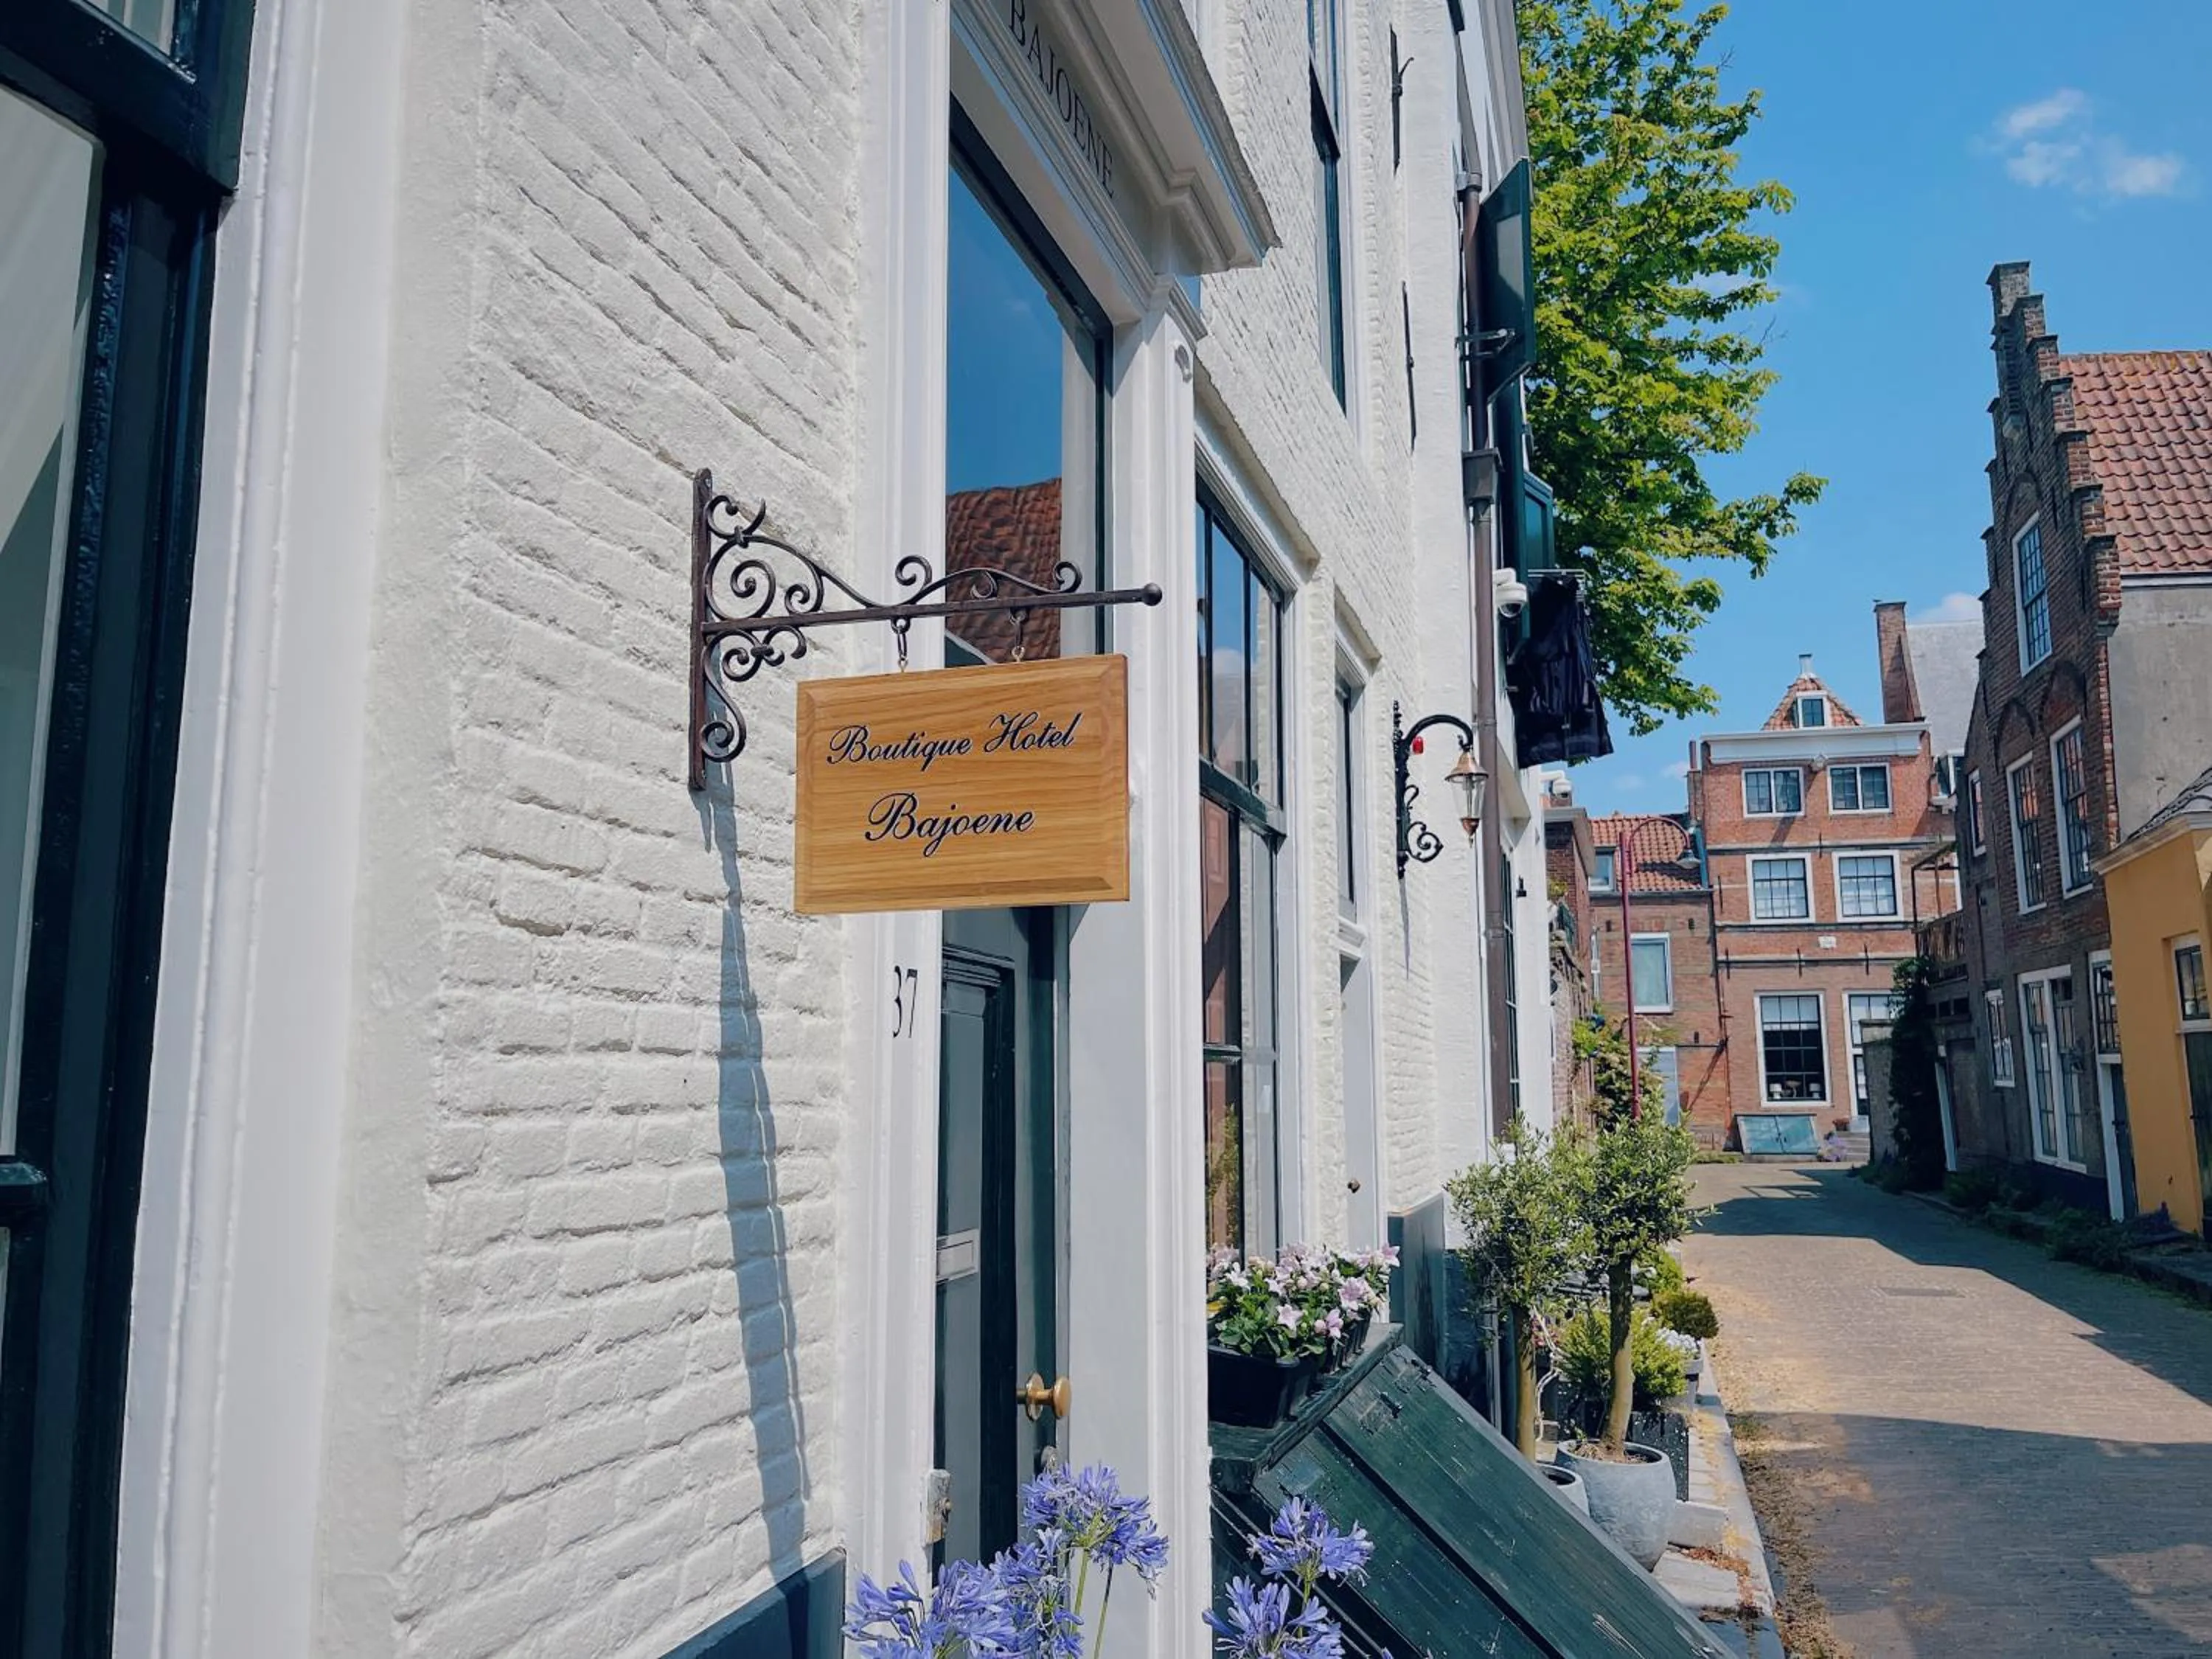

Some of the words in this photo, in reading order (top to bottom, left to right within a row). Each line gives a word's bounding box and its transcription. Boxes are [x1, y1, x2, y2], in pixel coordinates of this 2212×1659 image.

[1009, 0, 1113, 198] BAJOENE
[827, 725, 973, 772] Boutique
[984, 712, 1082, 753] Hotel
[865, 793, 1035, 857] Bajoene
[893, 965, 918, 1038] 37
